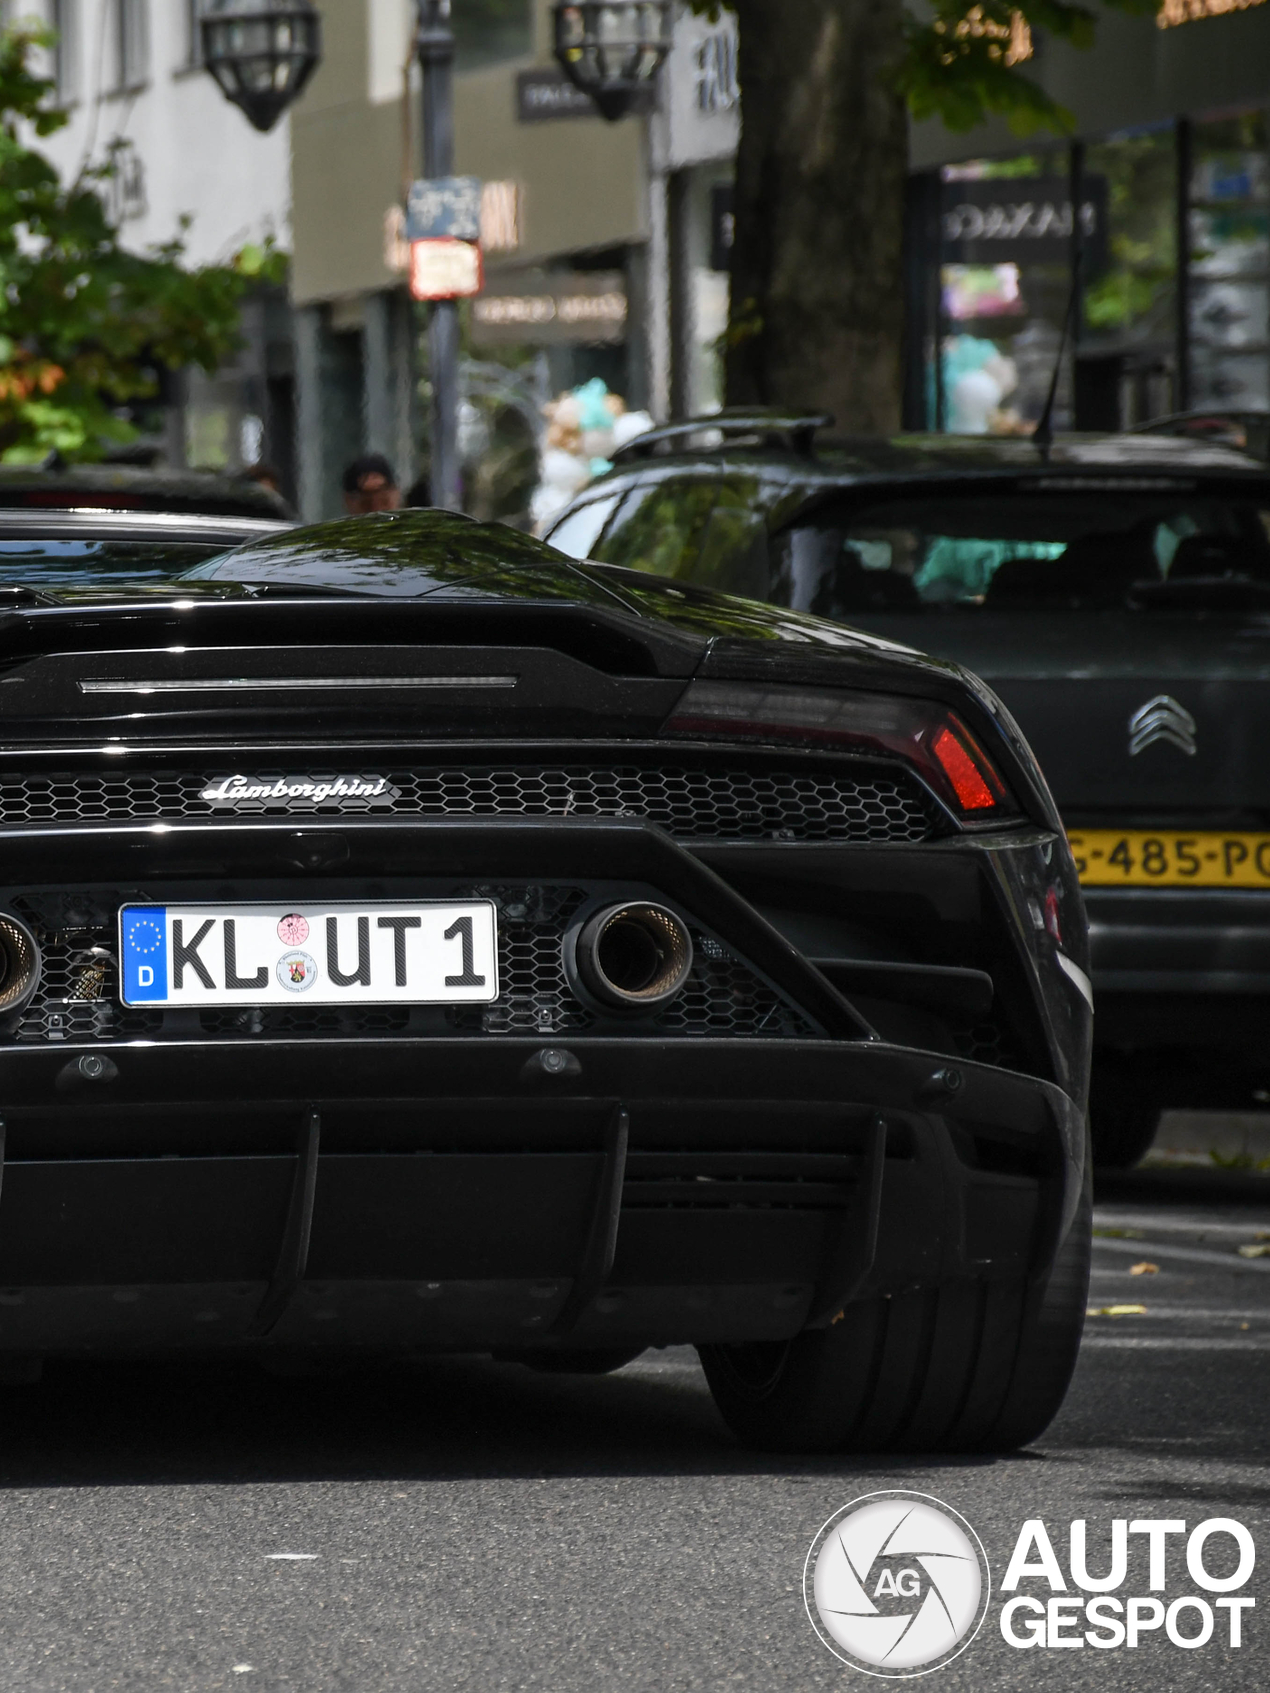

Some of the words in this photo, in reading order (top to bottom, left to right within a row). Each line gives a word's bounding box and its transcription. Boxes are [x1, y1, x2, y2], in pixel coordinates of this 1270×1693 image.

[202, 774, 387, 802] Lamborghini
[172, 918, 269, 990] KL
[326, 916, 422, 987] UT
[443, 916, 486, 987] 1
[138, 965, 155, 987] D
